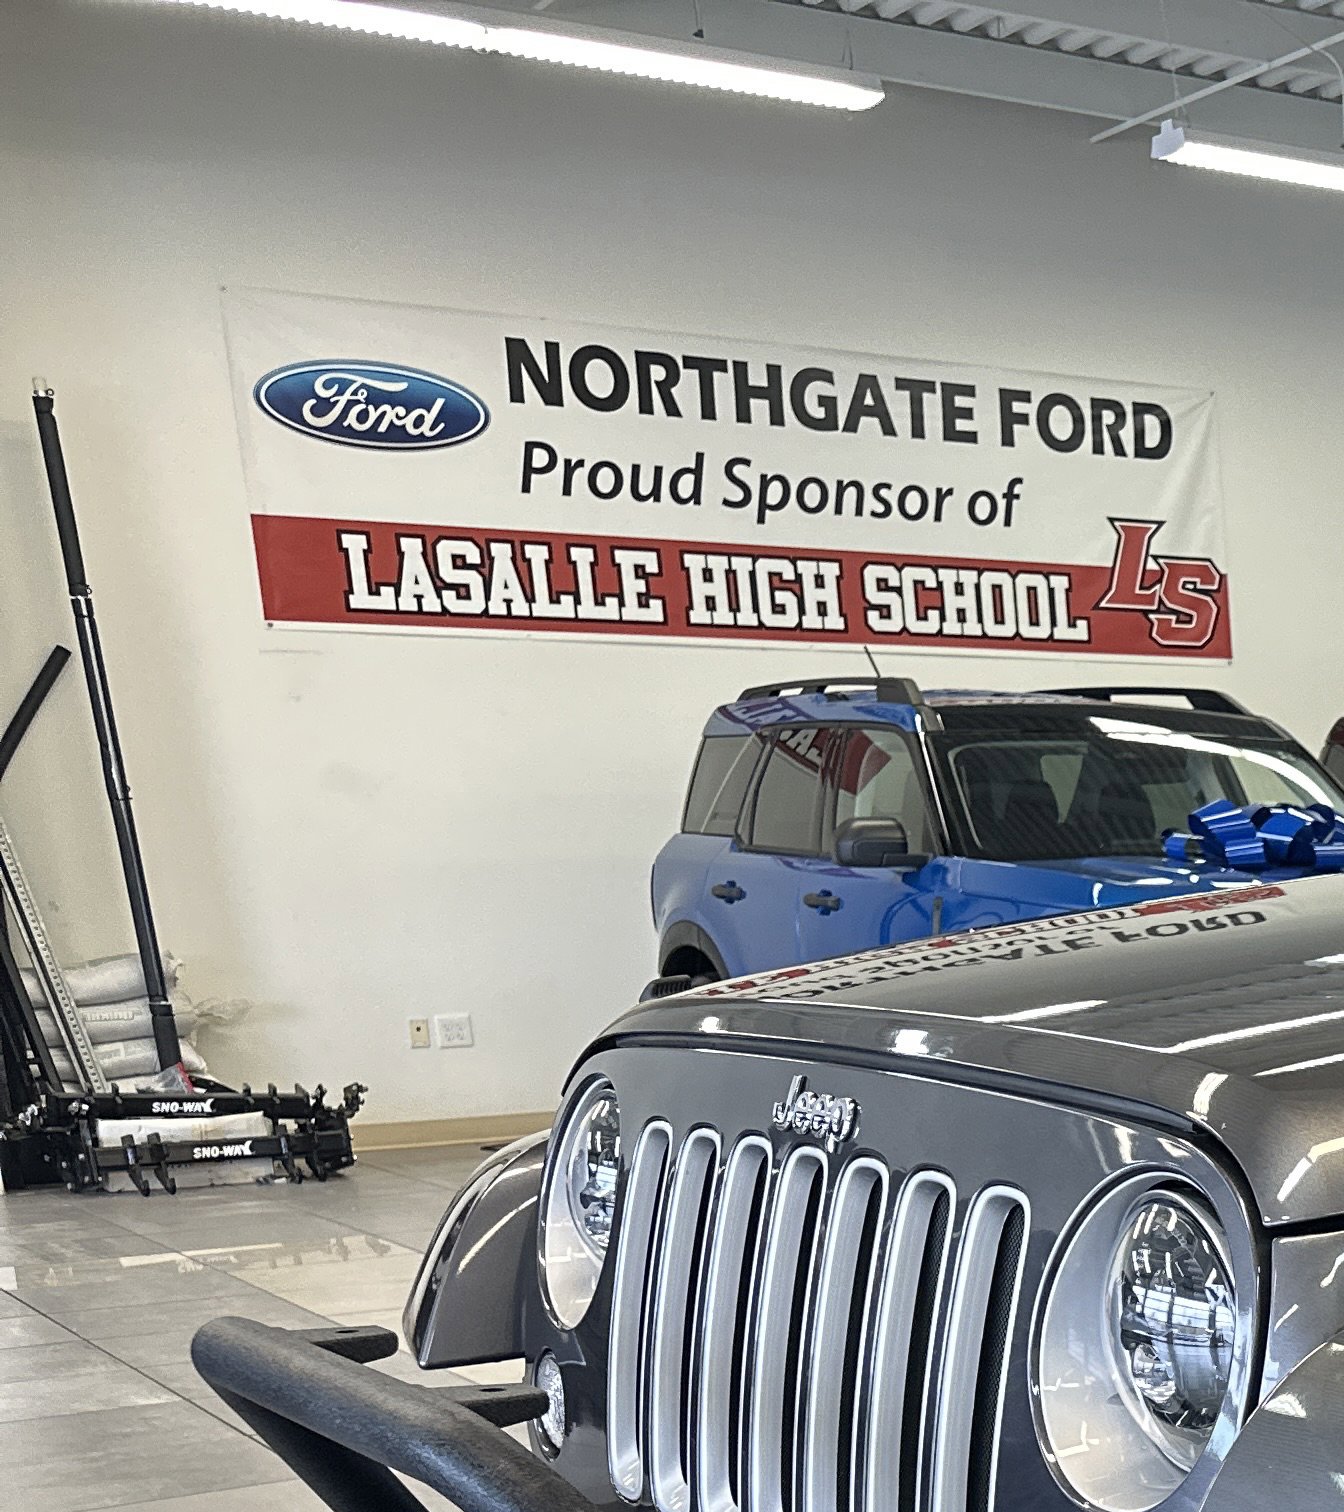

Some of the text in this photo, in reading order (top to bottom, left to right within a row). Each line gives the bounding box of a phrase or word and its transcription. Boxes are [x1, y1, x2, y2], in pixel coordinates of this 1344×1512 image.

[301, 371, 446, 439] Ford
[505, 336, 1172, 460] NORTHGATE FORD
[521, 441, 1023, 528] Proud Sponsor of
[336, 529, 1091, 644] LASALLE HIGH SCHOOL
[152, 1098, 215, 1113] SNO-WAY
[772, 1075, 858, 1153] Jeep
[193, 1140, 253, 1160] SNO-WAY
